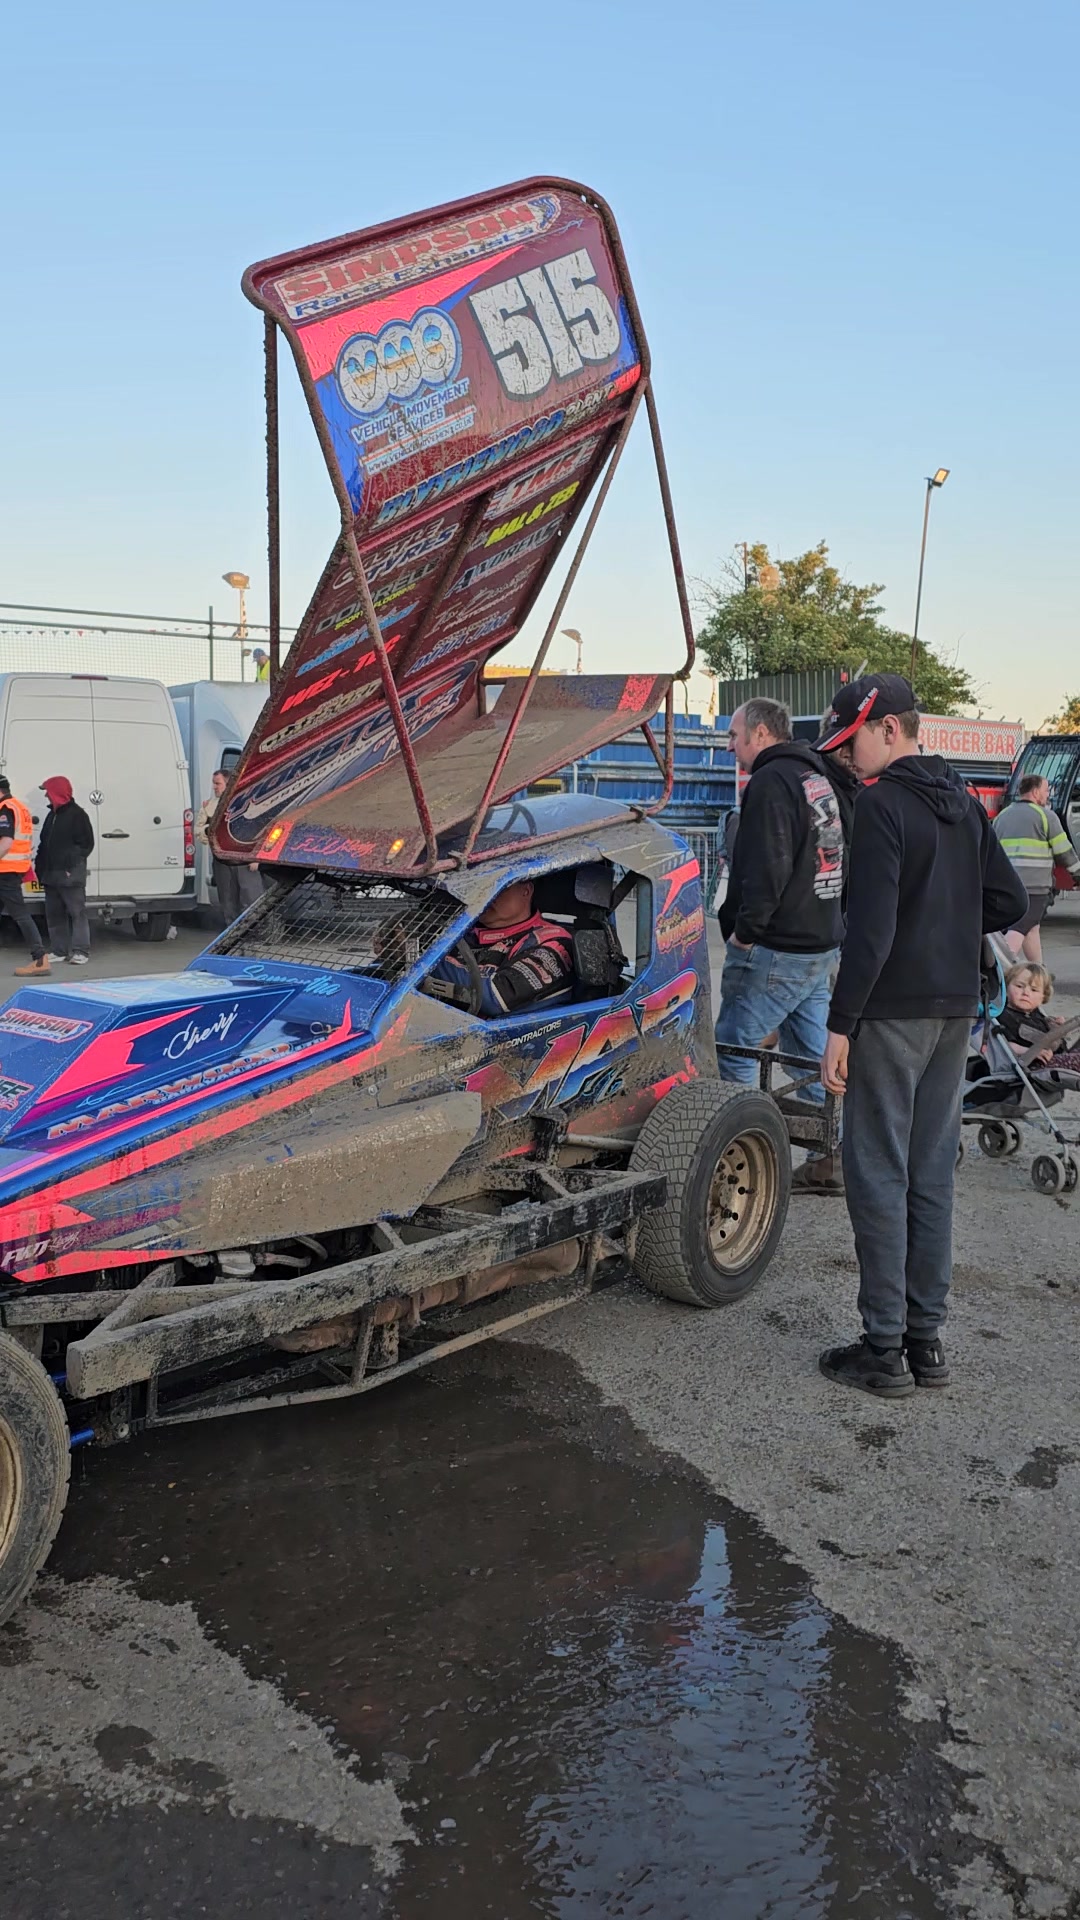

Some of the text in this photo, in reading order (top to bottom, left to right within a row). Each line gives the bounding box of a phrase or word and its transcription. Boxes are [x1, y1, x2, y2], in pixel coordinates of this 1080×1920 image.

[284, 204, 537, 302] SIMPSON
[294, 226, 534, 317] Race Exhausts
[469, 249, 621, 396] 515
[353, 381, 469, 441] VEHICLE MOVEMENT
[390, 408, 444, 440] SERVICES
[484, 511, 528, 548] MAL
[526, 502, 545, 525] &
[542, 481, 580, 515] ZEB
[367, 524, 459, 583] TYRES
[280, 668, 342, 714] WEZ
[917, 728, 1015, 755] BURGER BAR
[268, 739, 373, 806] PROMOTIONS
[0, 1011, 80, 1034] SIMPSON
[506, 1019, 562, 1050] CONTRACTORS
